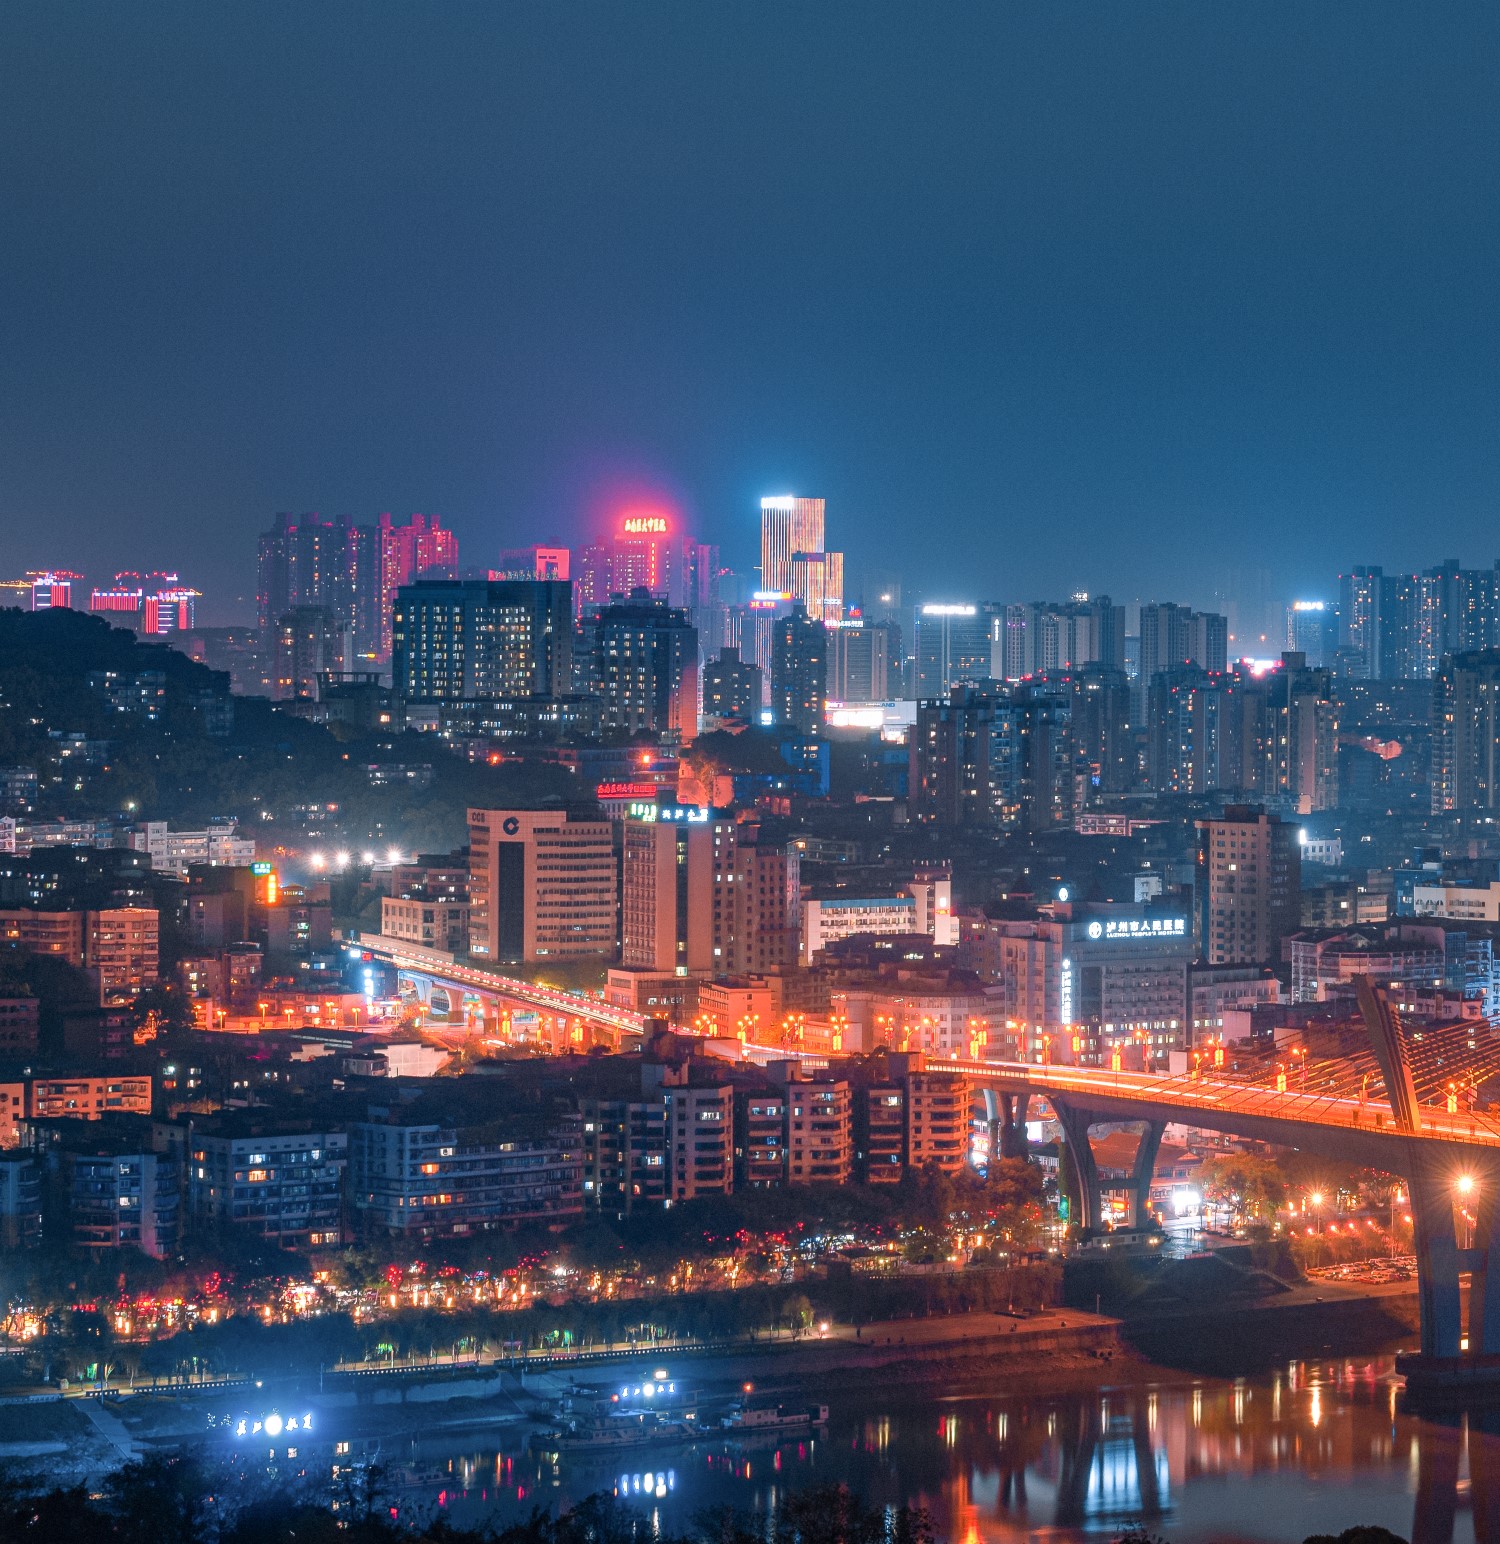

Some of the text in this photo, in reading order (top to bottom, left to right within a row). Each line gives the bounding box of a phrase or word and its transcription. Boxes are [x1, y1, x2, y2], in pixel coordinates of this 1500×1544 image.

[471, 812, 486, 823] CCB
[1106, 919, 1185, 933] 泸州市人民医院
